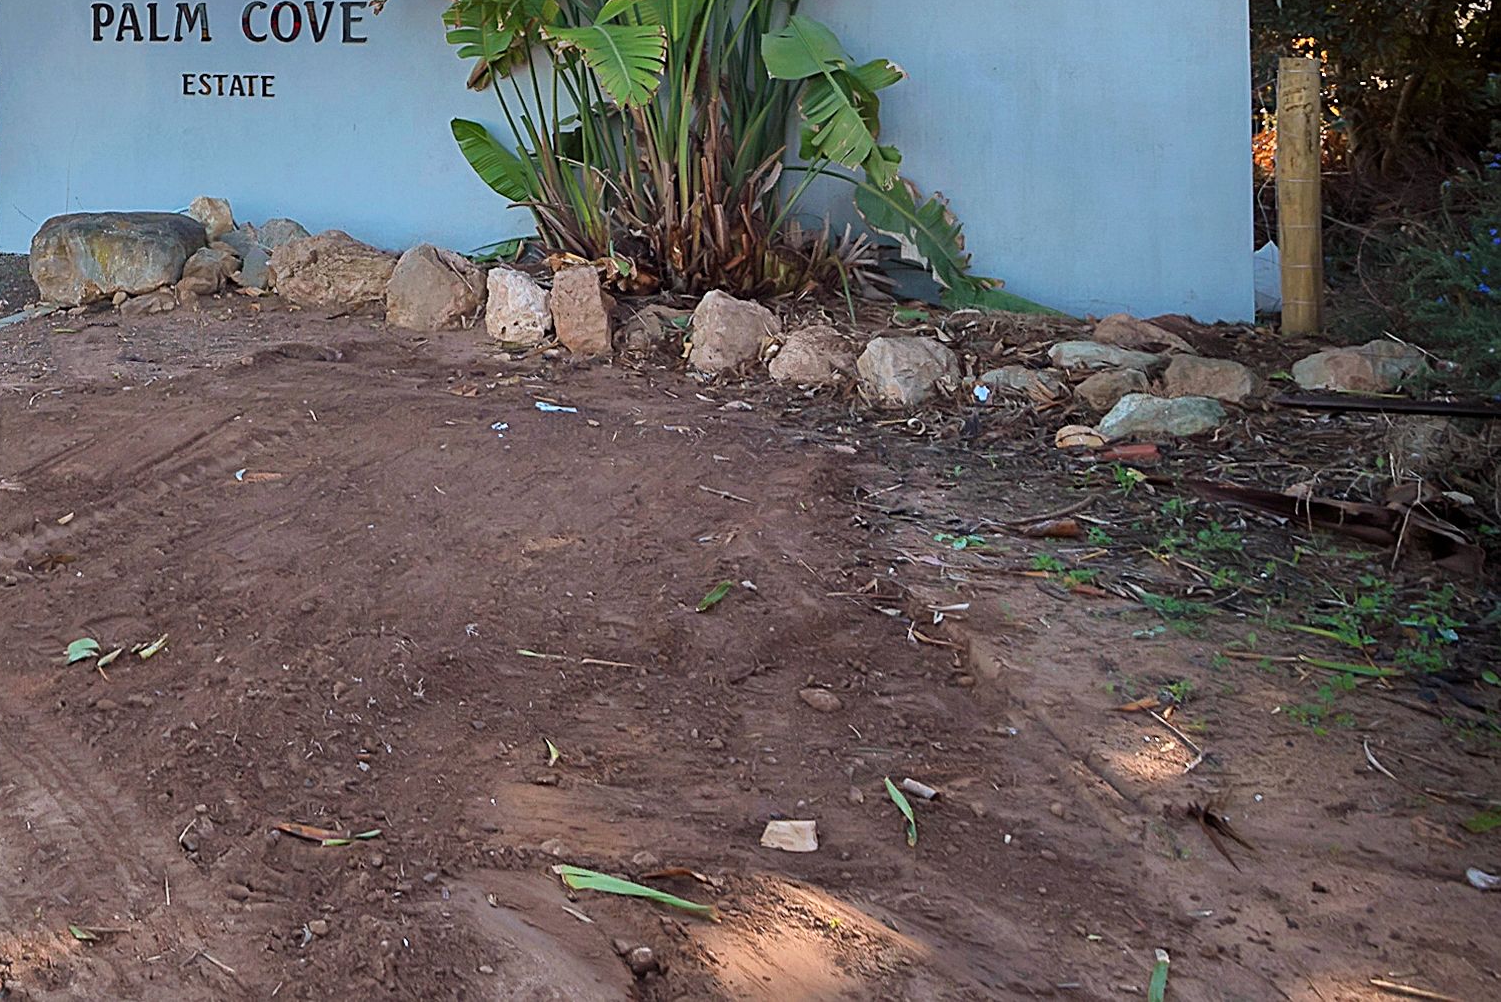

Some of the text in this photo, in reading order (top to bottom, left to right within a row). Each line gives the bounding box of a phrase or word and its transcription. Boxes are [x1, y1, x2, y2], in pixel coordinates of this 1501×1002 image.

[91, 1, 368, 43] PALM COVE
[182, 73, 275, 97] ESTATE
